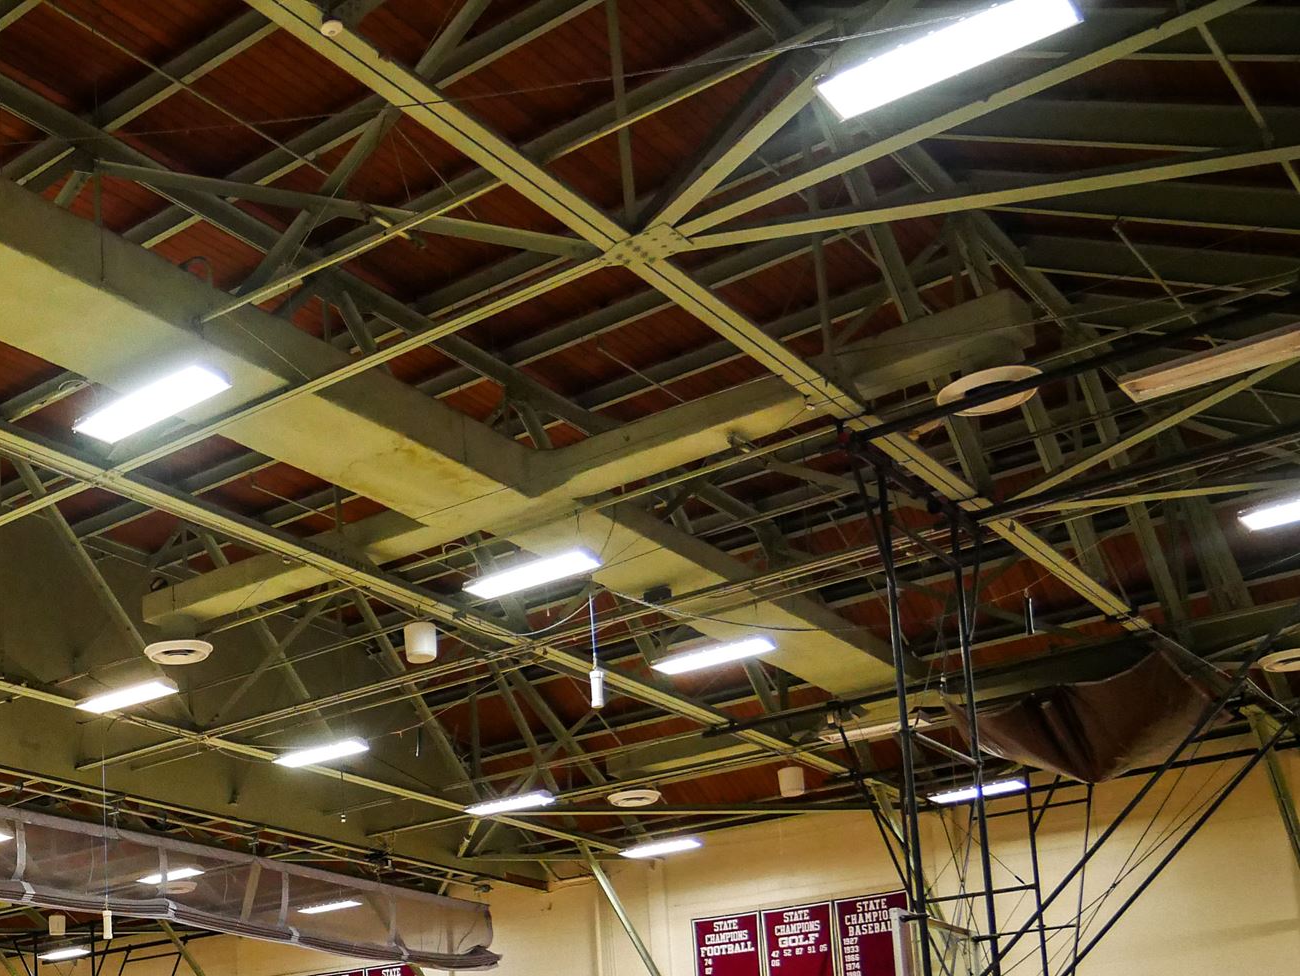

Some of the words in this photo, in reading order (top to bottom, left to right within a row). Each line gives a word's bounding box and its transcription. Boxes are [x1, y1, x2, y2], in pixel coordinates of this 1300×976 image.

[856, 898, 888, 912] STATE
[783, 909, 810, 923] STATE
[844, 909, 890, 926] CHAMPIO
[713, 919, 739, 932] STATE
[774, 919, 821, 936] CHAMPIONS
[848, 920, 892, 937] BASEBAL
[705, 929, 748, 945] CHAMPIONS
[778, 933, 819, 948] GOLF
[700, 941, 755, 957] FOOTBALL
